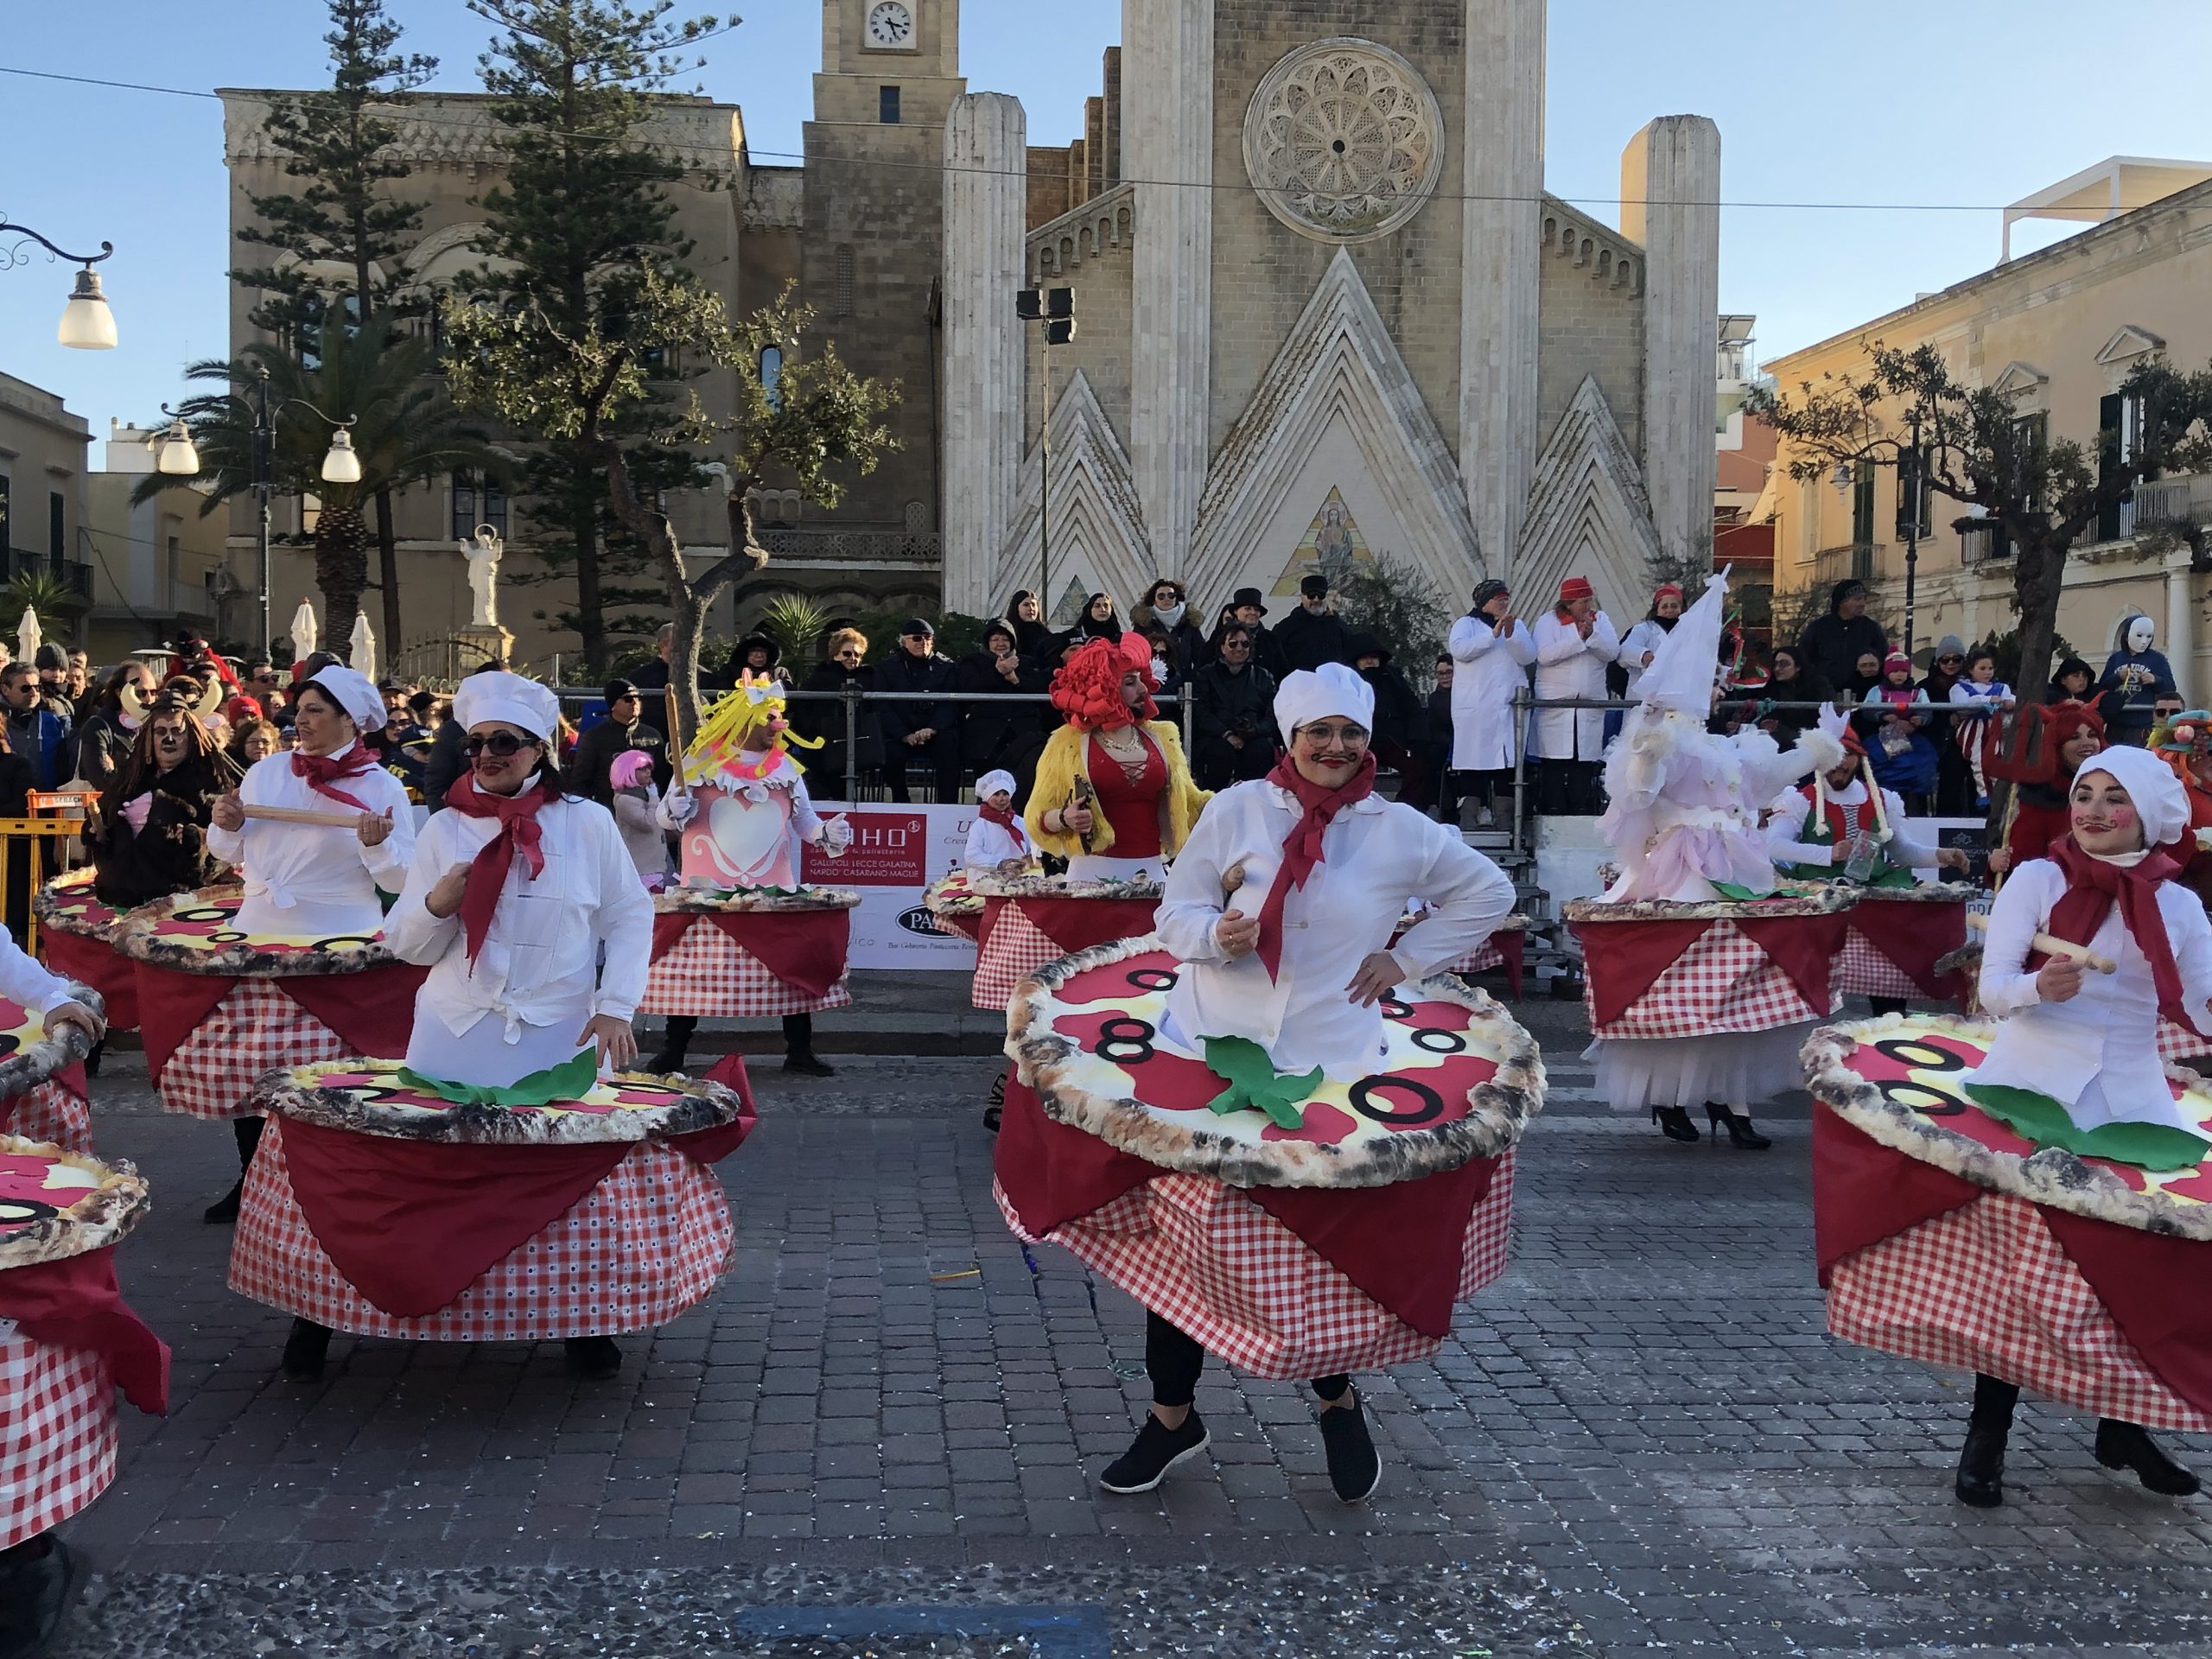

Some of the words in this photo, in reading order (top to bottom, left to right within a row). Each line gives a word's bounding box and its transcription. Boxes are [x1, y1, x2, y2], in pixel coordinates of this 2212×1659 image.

[810, 859, 849, 868] GALLIPOLI
[843, 868, 887, 877] CASARANO
[910, 912, 935, 930] PA
